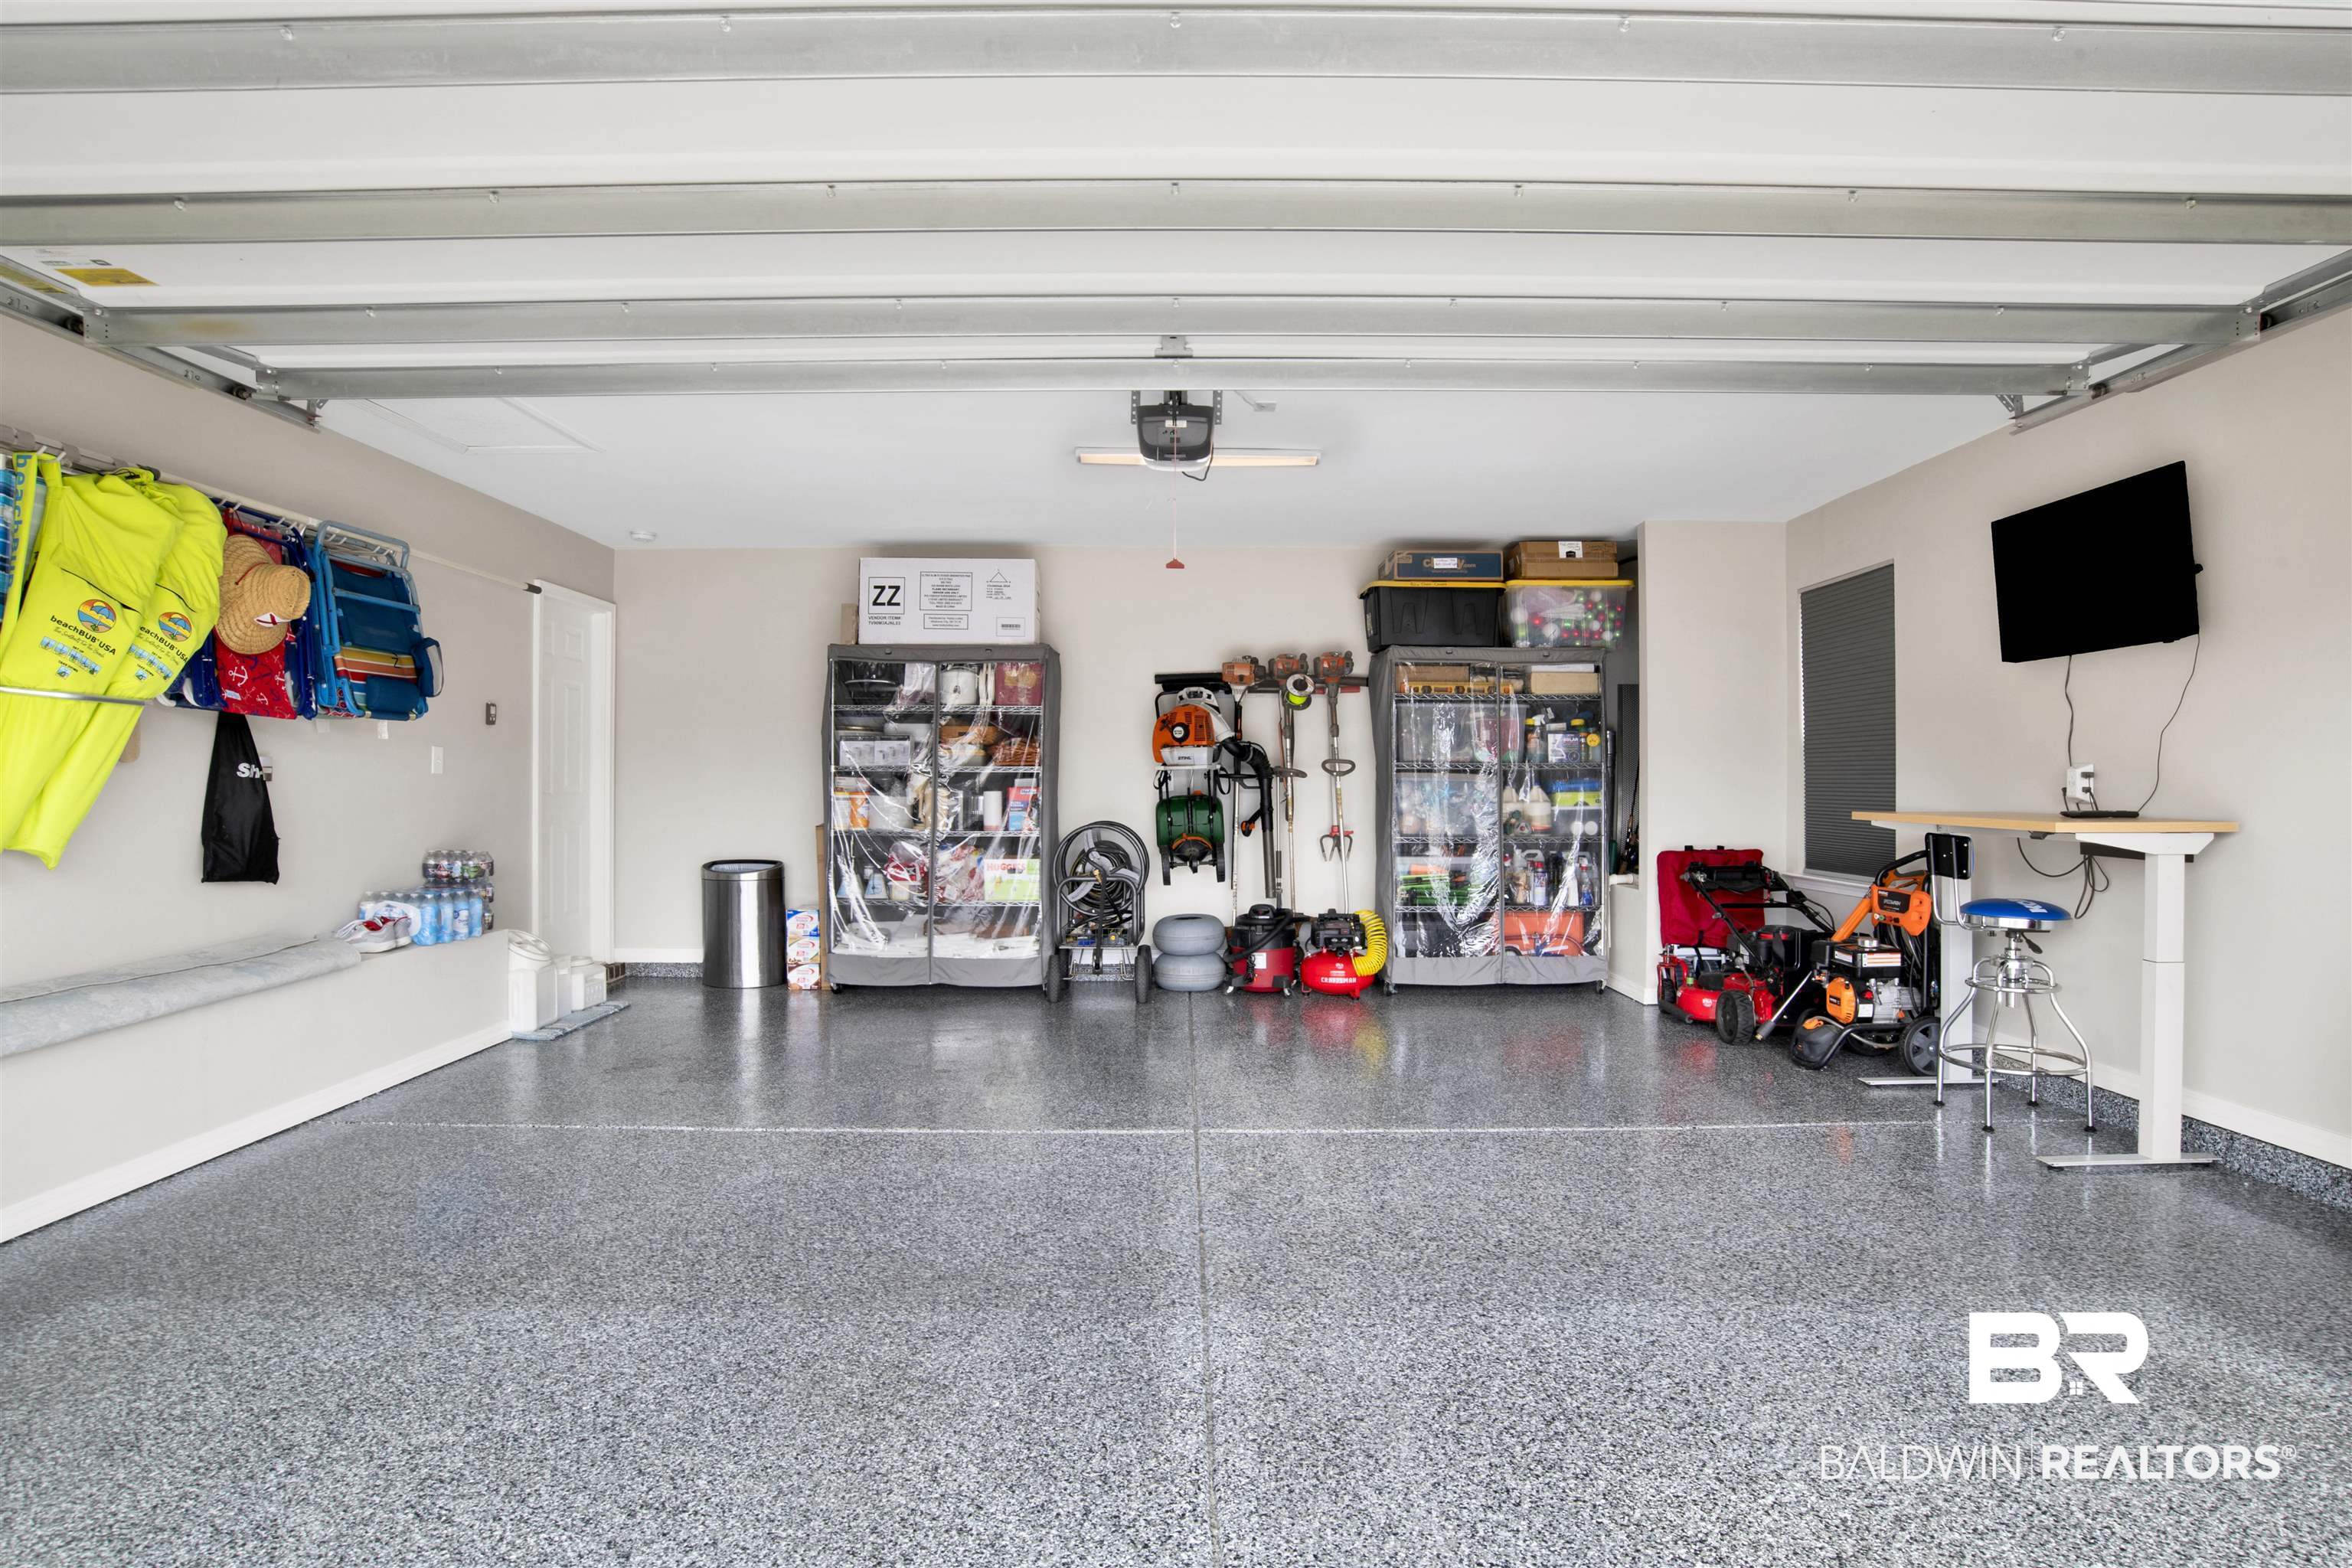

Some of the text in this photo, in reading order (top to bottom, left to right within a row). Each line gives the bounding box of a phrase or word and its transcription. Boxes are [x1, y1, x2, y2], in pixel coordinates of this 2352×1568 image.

[872, 585, 901, 606] ZZ
[98, 641, 117, 655] USA
[139, 626, 175, 652] eachBUB
[237, 763, 263, 779] Sh
